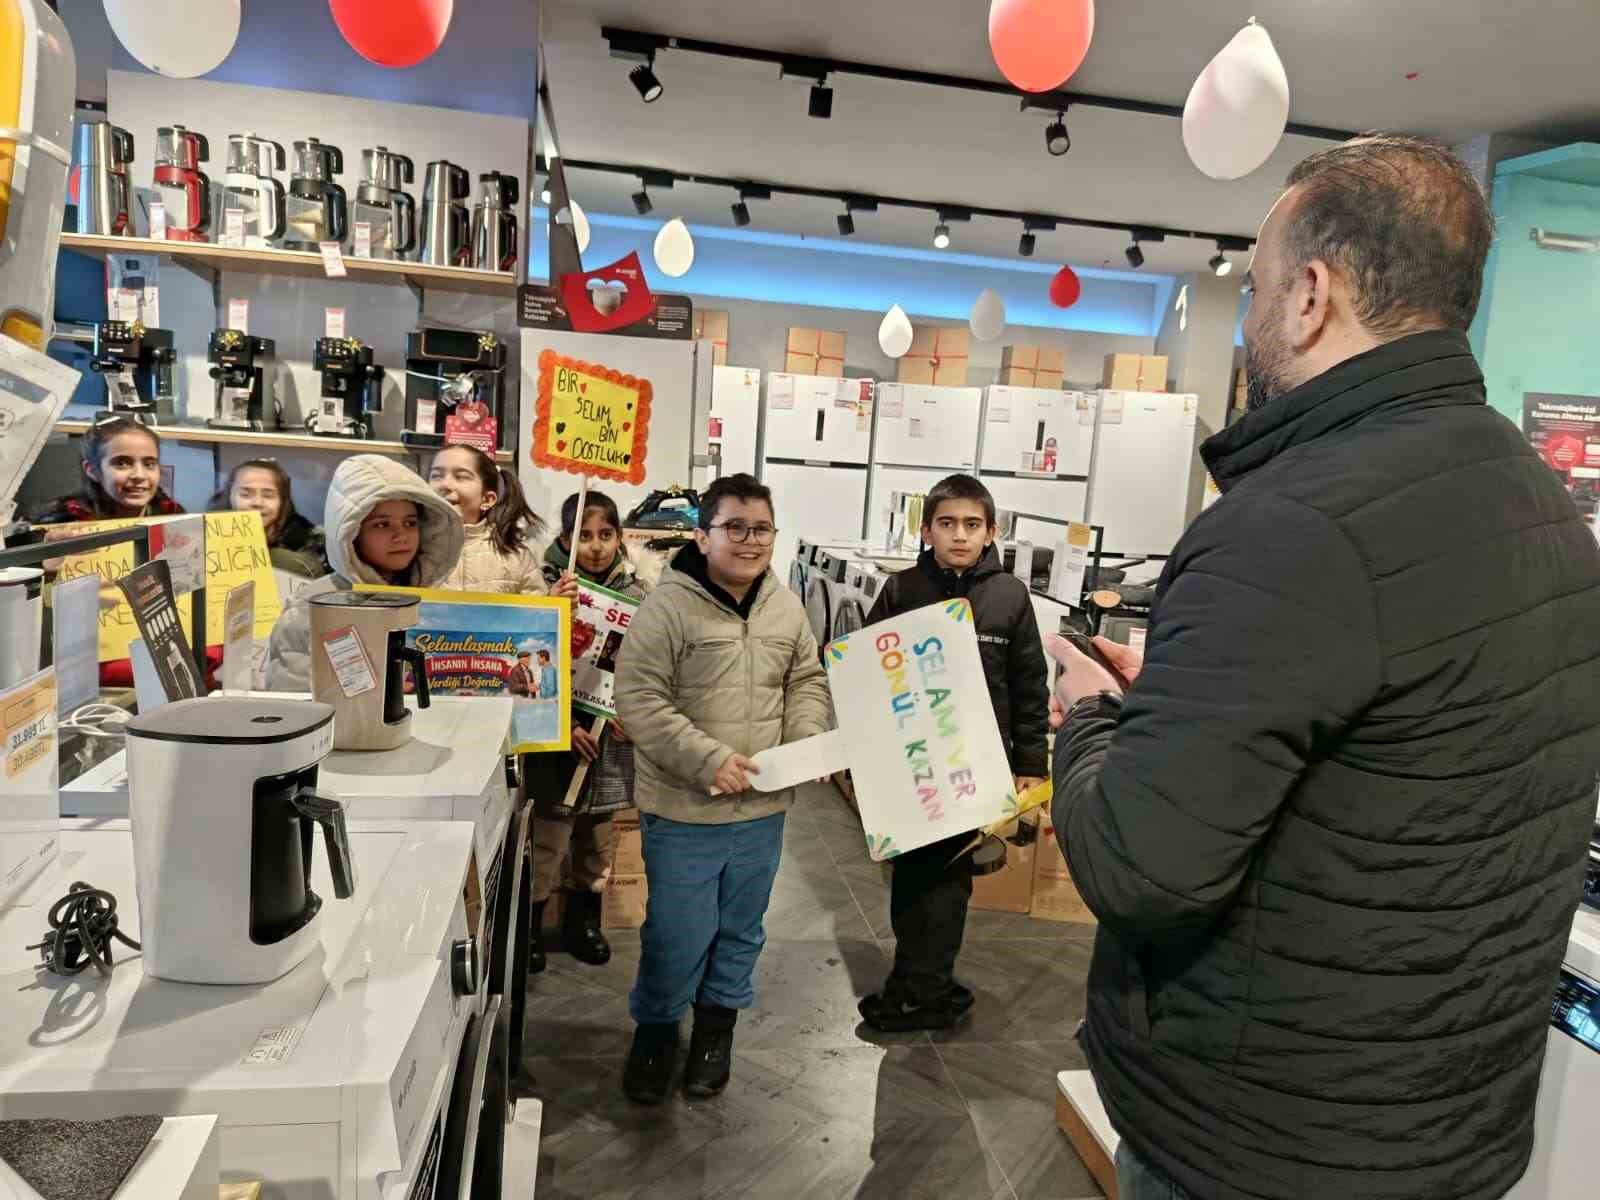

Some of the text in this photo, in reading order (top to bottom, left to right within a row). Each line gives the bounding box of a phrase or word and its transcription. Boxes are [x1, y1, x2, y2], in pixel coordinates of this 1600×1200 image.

[875, 631, 945, 822] GÖNÜL KAZAN
[912, 636, 977, 801] SELAM VER
